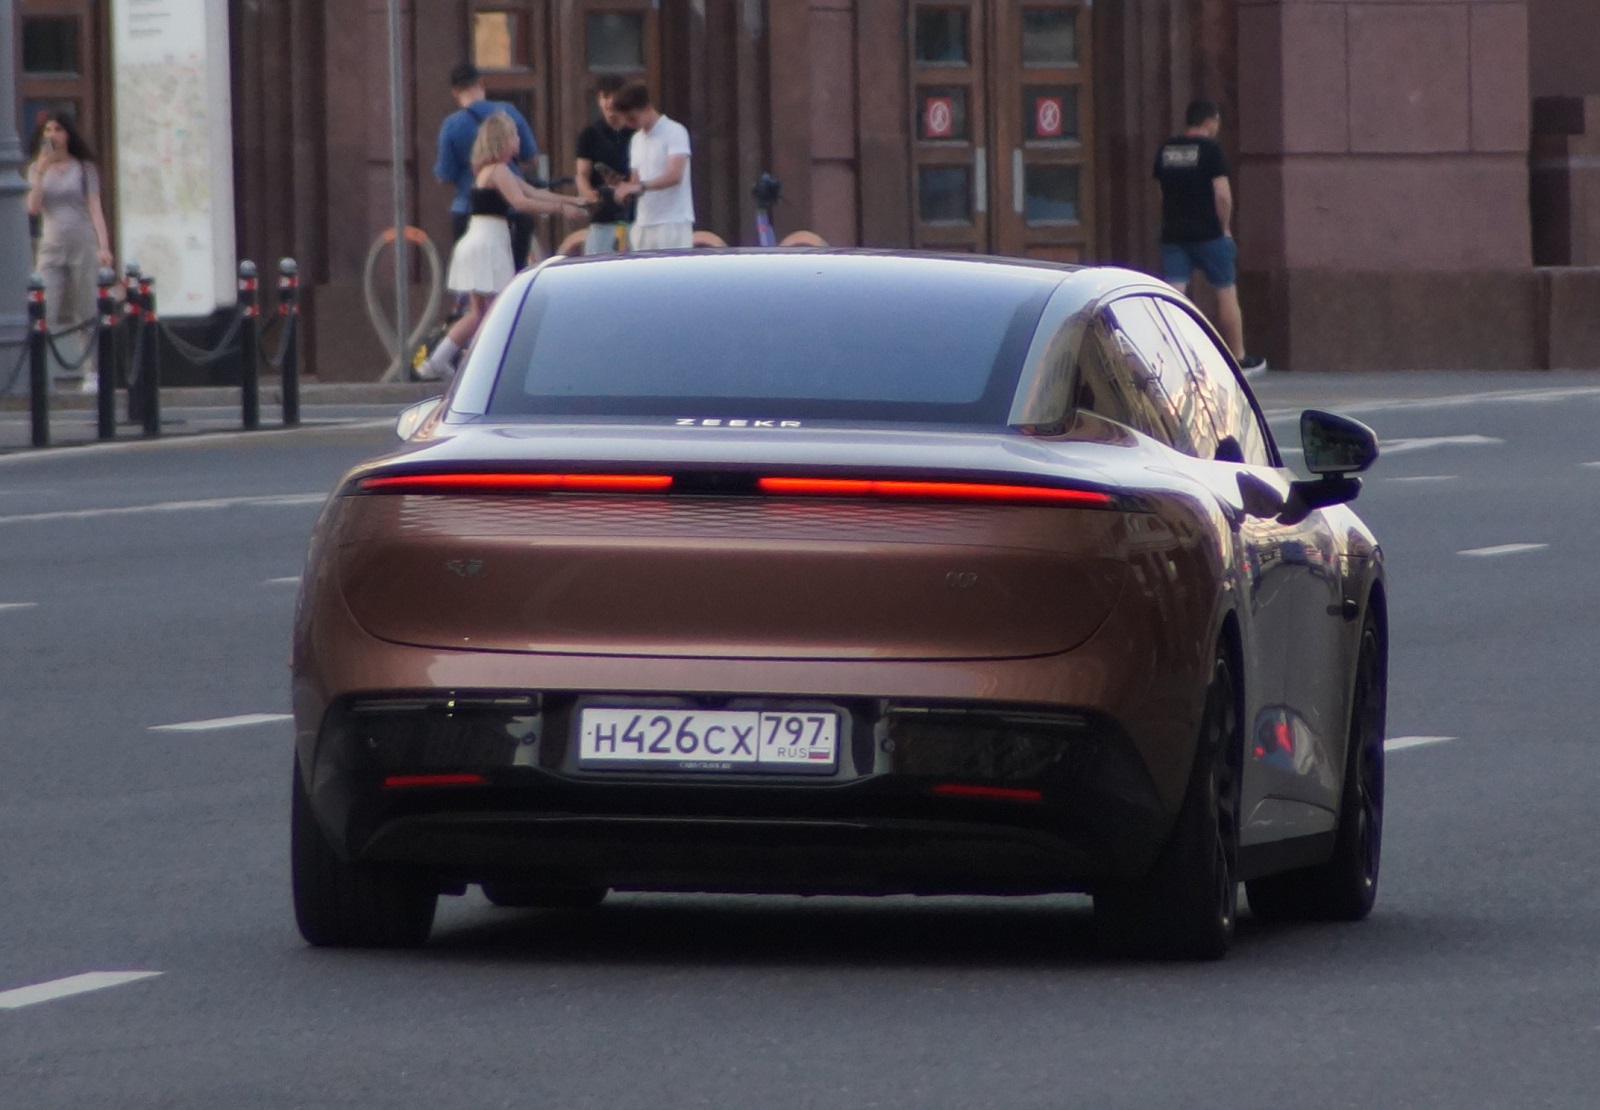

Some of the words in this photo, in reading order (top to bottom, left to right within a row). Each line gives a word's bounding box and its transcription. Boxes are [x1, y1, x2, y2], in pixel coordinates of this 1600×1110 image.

[675, 418, 801, 428] ZEEKR
[764, 715, 826, 747] 797
[777, 747, 807, 759] RUS
